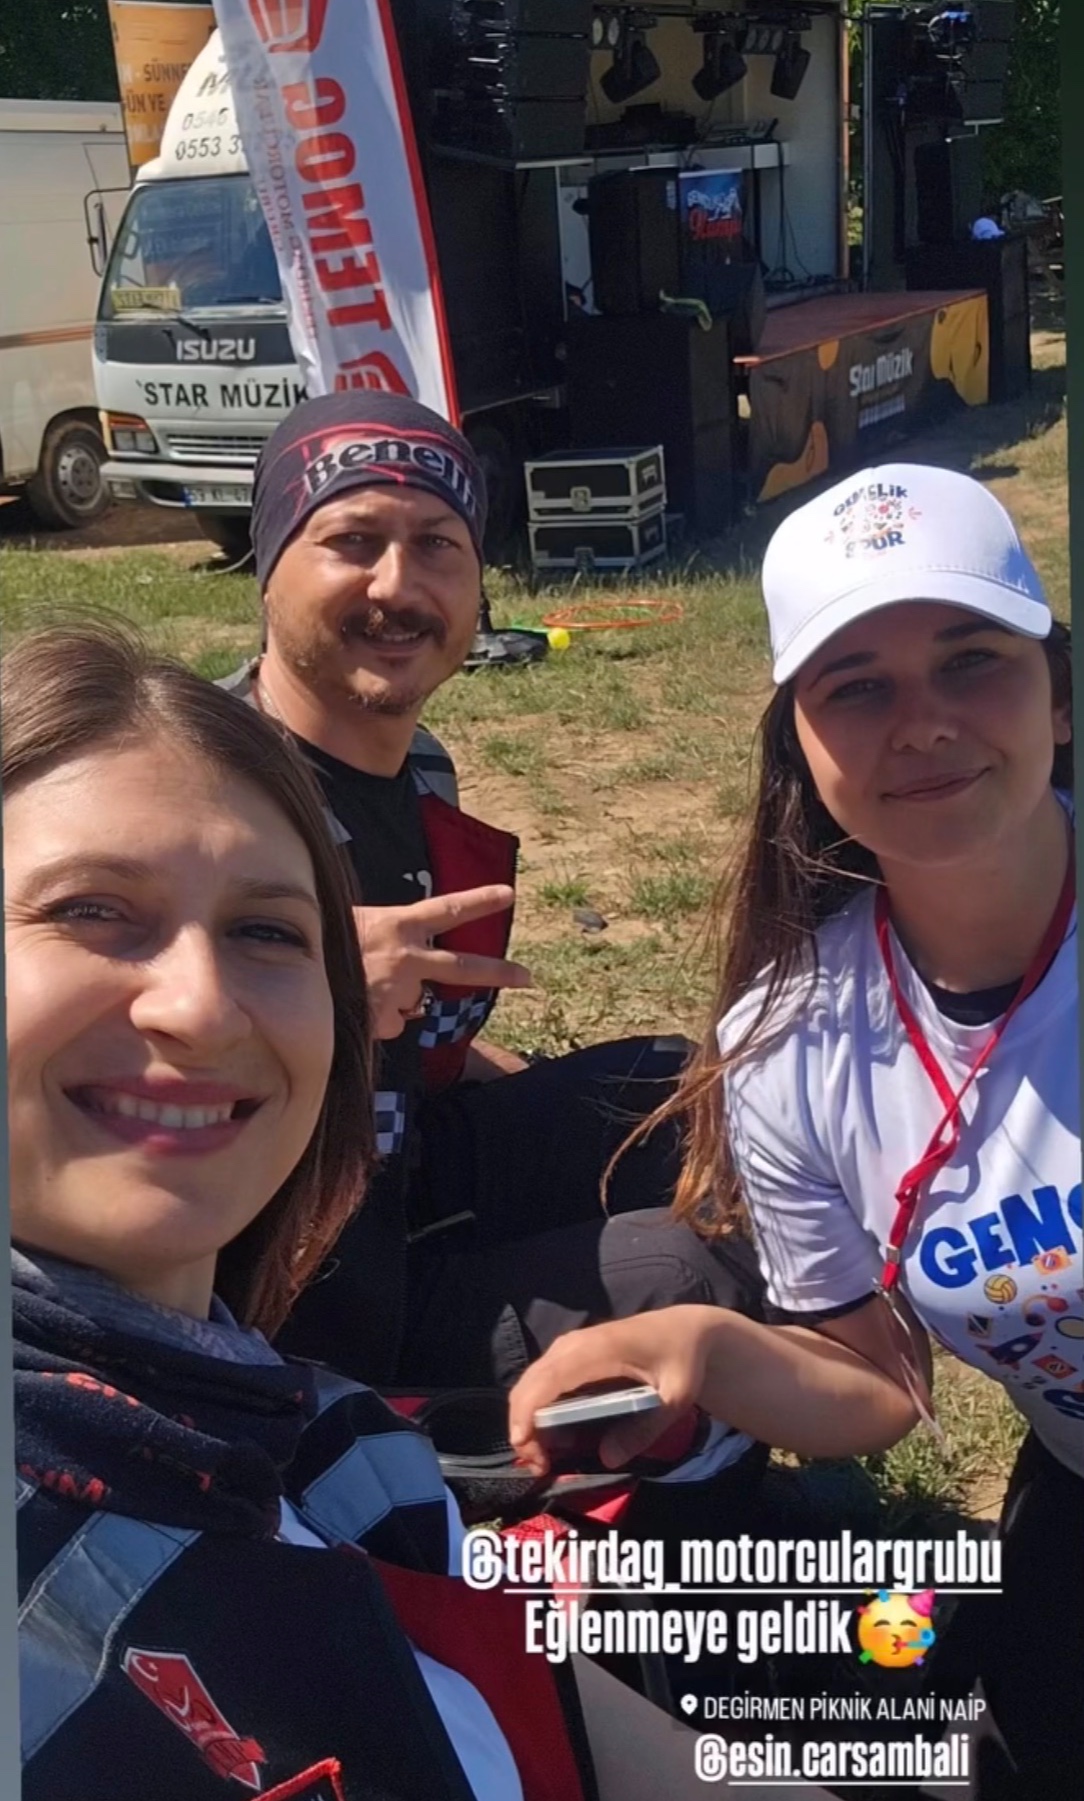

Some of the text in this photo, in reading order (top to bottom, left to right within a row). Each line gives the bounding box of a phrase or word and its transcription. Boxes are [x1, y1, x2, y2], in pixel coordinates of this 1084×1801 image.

[143, 58, 193, 82] SÜNNE
[125, 88, 147, 113] ÜN
[175, 134, 244, 161] 0553 3
[176, 338, 256, 361] ISUZU
[220, 377, 309, 408] MÜZİK
[303, 438, 477, 516] Benelli
